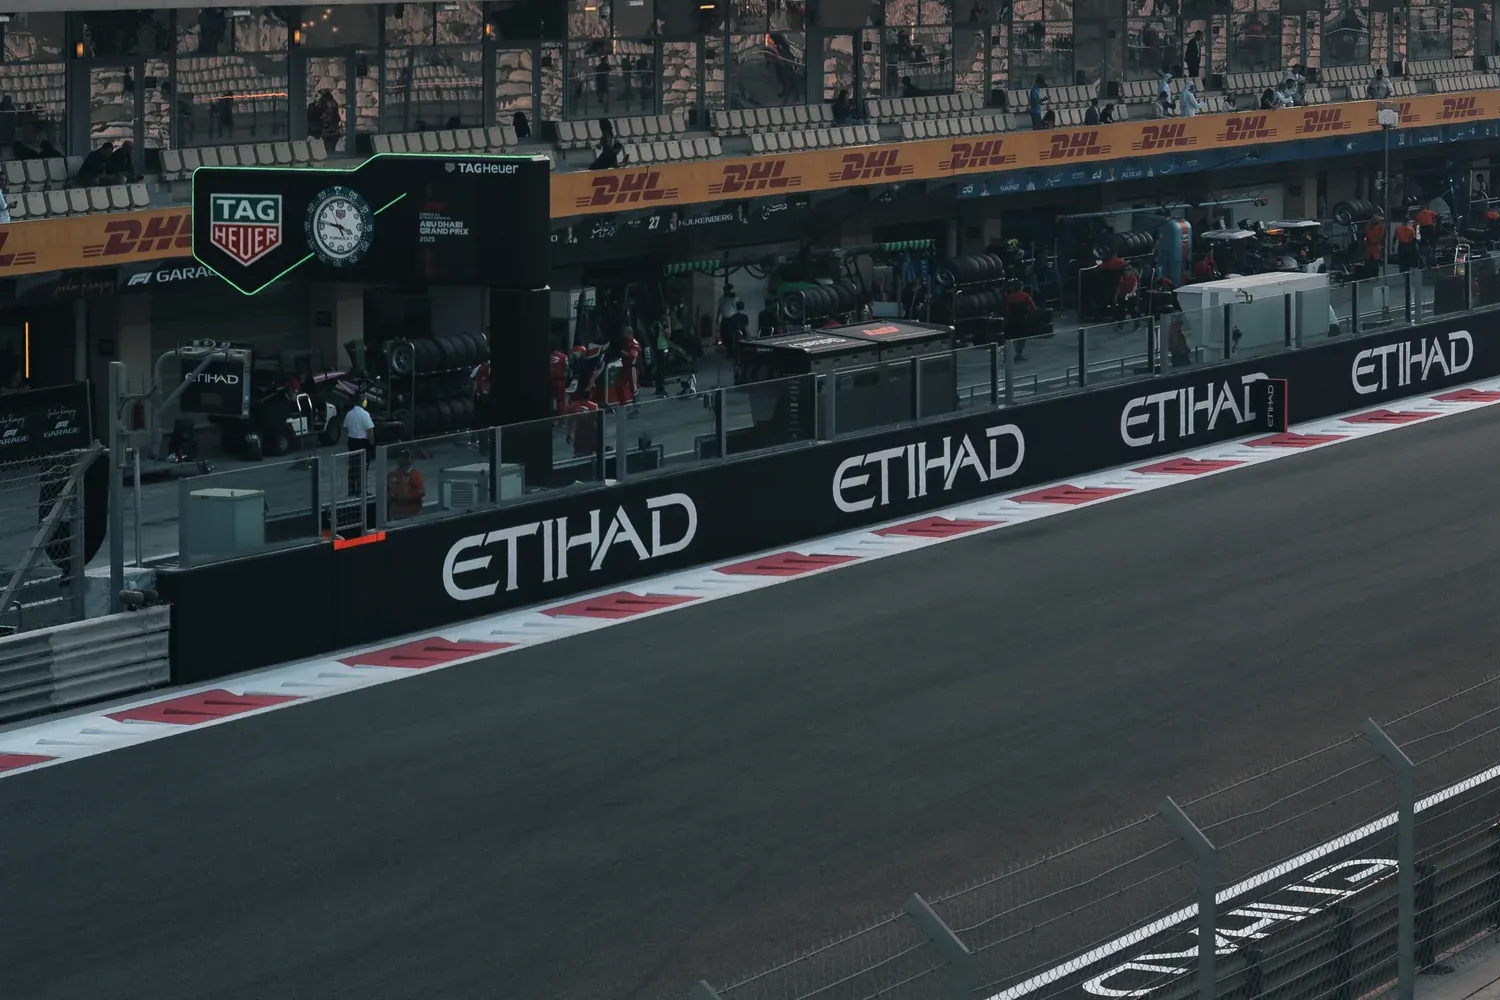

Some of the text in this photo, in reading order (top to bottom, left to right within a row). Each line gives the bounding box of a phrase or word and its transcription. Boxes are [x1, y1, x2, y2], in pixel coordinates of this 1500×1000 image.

[1443, 97, 1479, 119] DHL
[1227, 116, 1269, 140] DHL
[1304, 109, 1342, 133] DHL
[1051, 132, 1101, 158] DHL
[1142, 124, 1187, 149] DHL
[842, 149, 903, 181] DHL
[951, 140, 1006, 169] DHL
[590, 171, 664, 206] DHL
[721, 160, 791, 193] DHL
[349, 191, 358, 200] 05
[216, 199, 275, 220] TAG
[438, 221, 463, 229] DHABI
[647, 216, 661, 230] 27
[214, 226, 277, 260] HEUER
[1351, 329, 1474, 395] ETIHAD
[1266, 383, 1275, 428] ETIHAD
[0, 435, 30, 446] ARAGE
[43, 427, 81, 439] GARAGE
[832, 424, 1025, 513] ETIHAD
[442, 492, 698, 601] ETIHAD
